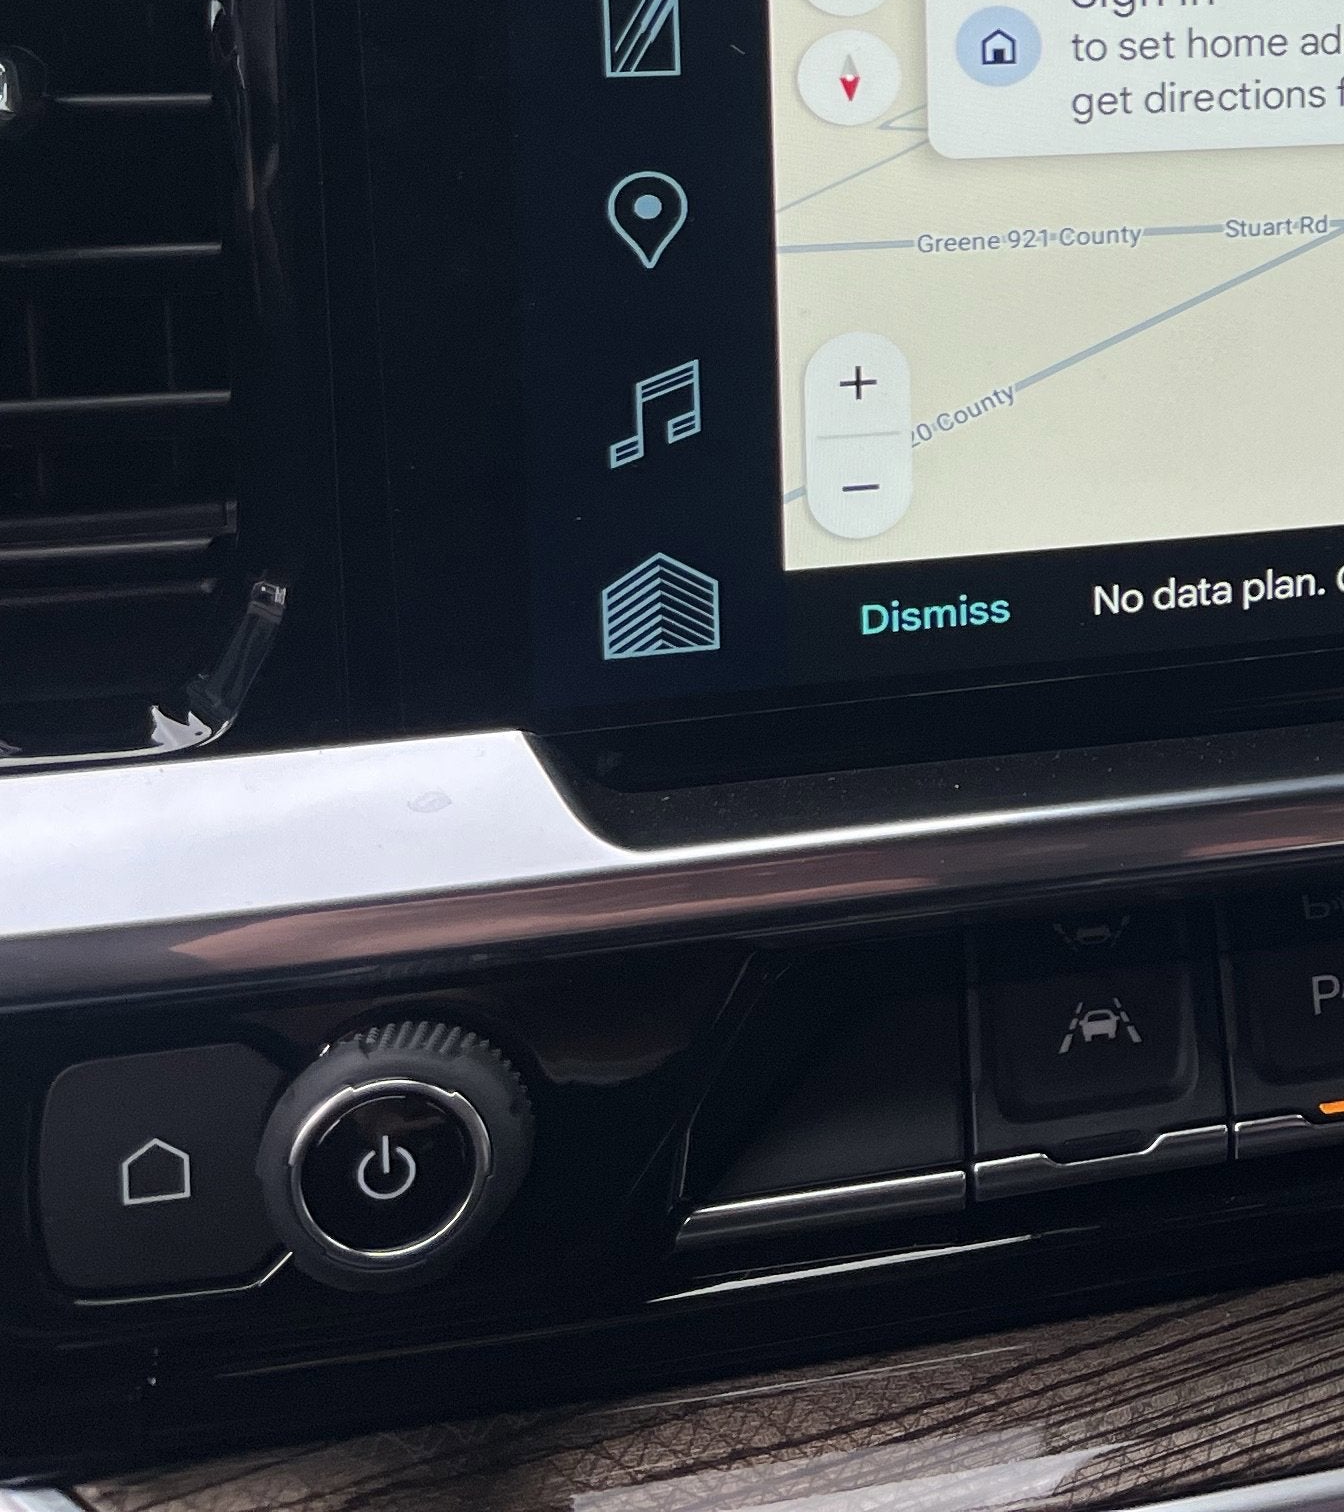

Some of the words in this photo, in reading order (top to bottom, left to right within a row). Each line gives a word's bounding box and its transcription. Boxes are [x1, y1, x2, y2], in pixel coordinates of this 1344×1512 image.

[1071, 32, 1108, 62] to
[1119, 31, 1176, 61] set
[1188, 27, 1288, 58] home
[1072, 86, 1133, 125] get
[1144, 79, 1327, 114] directions
[916, 233, 1000, 254] Greene
[1007, 228, 1049, 249] 921
[1059, 225, 1142, 248] County
[1224, 218, 1293, 238] Stuart
[1299, 214, 1328, 235] Rd
[936, 386, 1014, 431] County
[1092, 585, 1144, 616] No
[1152, 577, 1233, 611] data
[1241, 569, 1327, 610] plan.
[861, 594, 1011, 635] Dismiss
